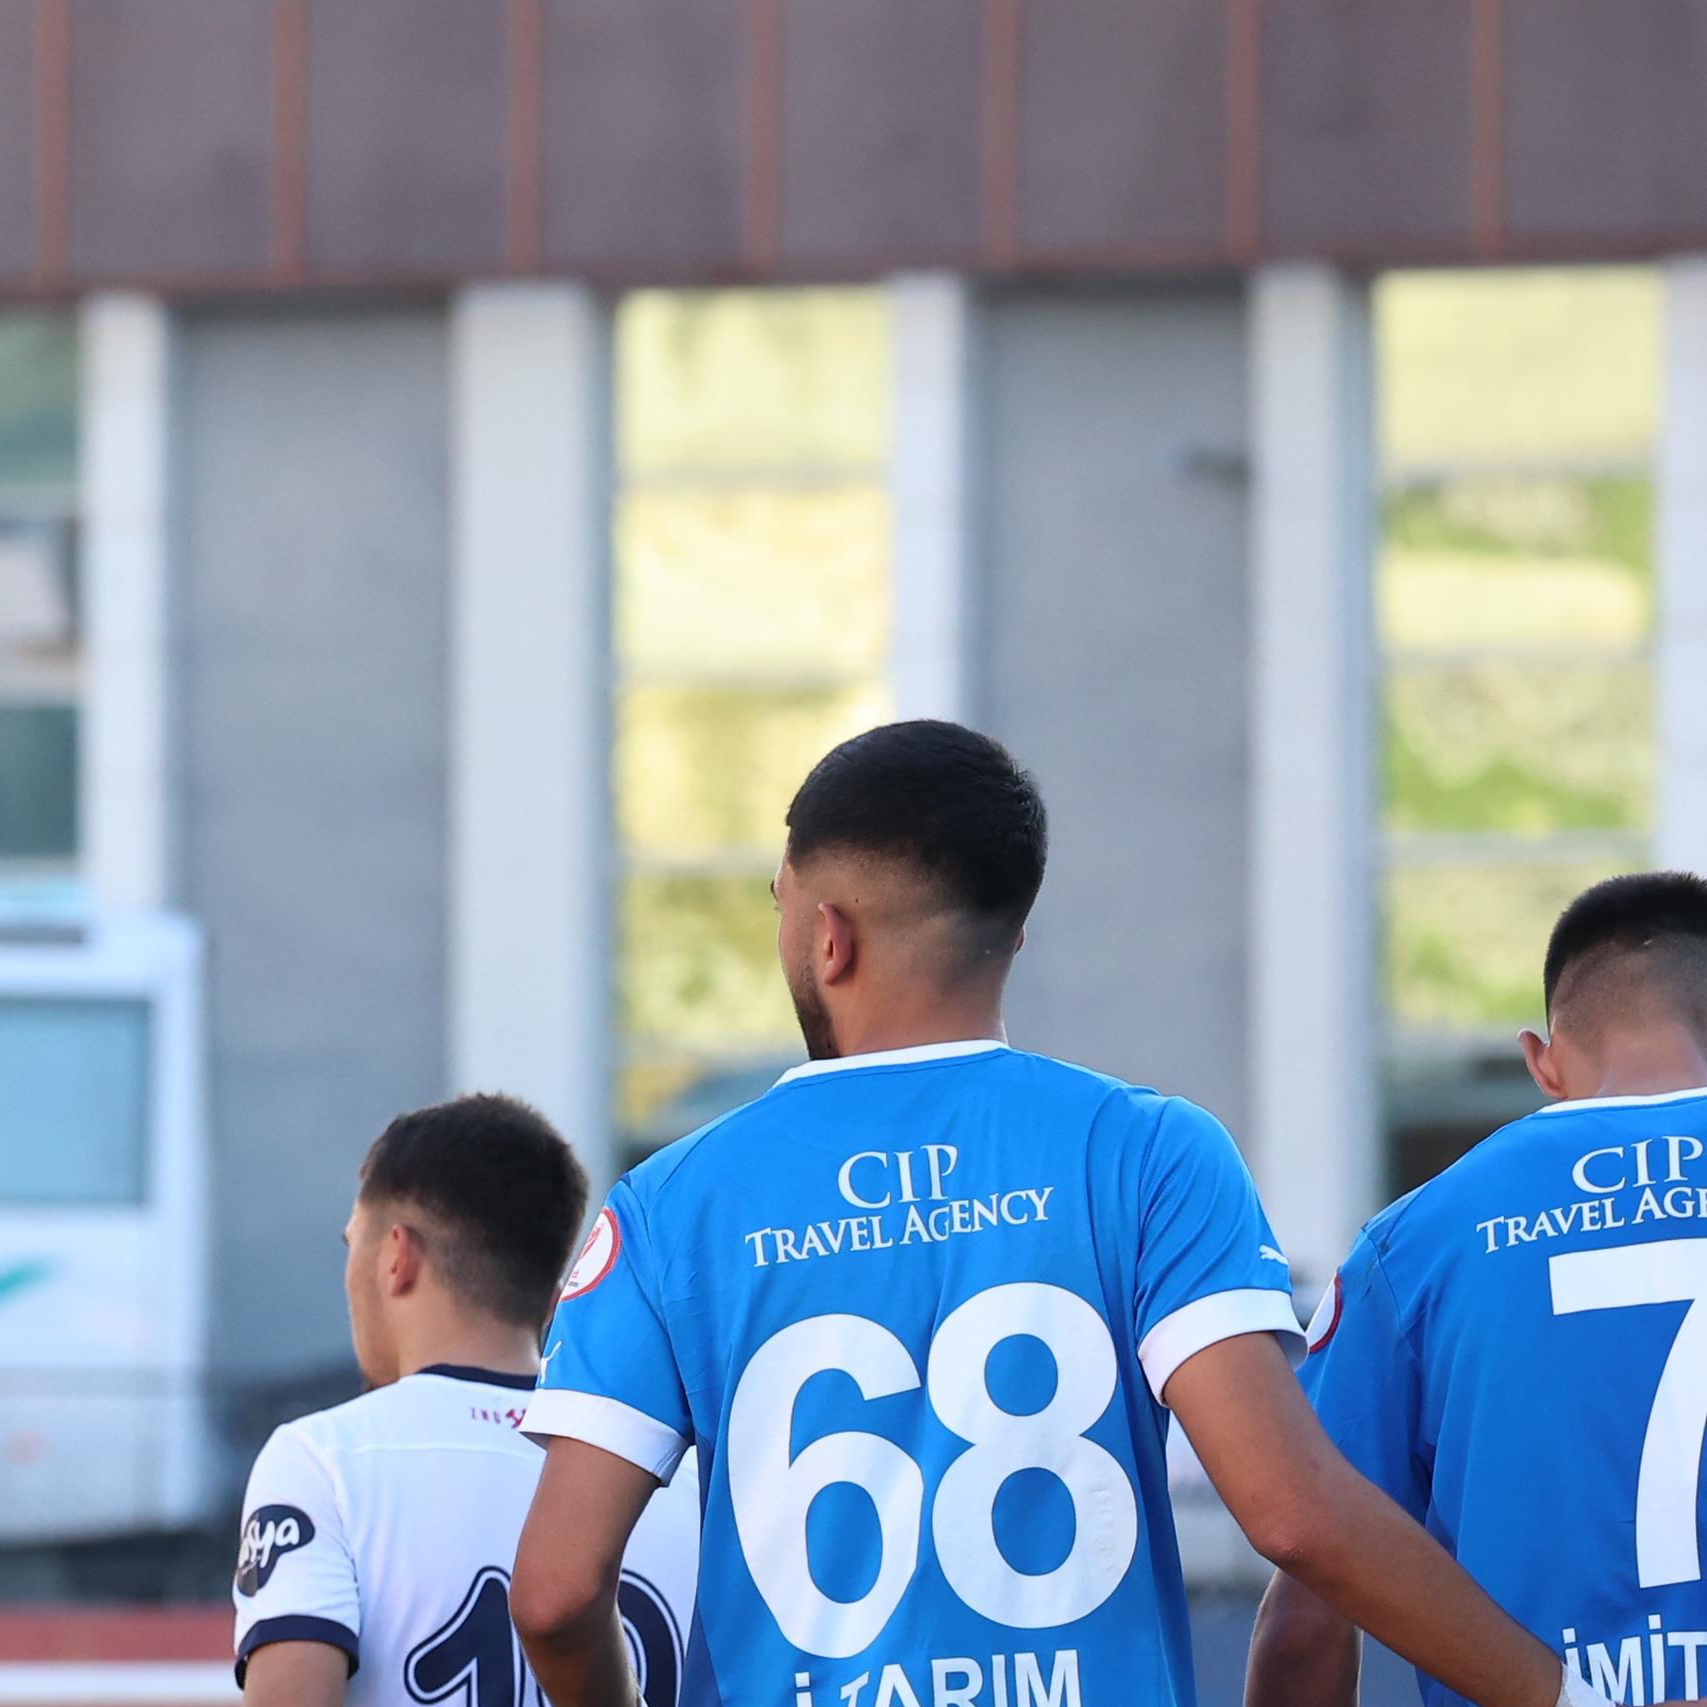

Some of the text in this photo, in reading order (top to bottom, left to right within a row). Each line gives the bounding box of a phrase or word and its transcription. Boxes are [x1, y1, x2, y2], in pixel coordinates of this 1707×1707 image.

[837, 1144, 958, 1209] CIP
[1571, 1135, 1704, 1194] CIP
[744, 1186, 1054, 1268] TRAVEL AGENCY
[1475, 1197, 1626, 1254] TRAVEL
[727, 1281, 1138, 1659] 68
